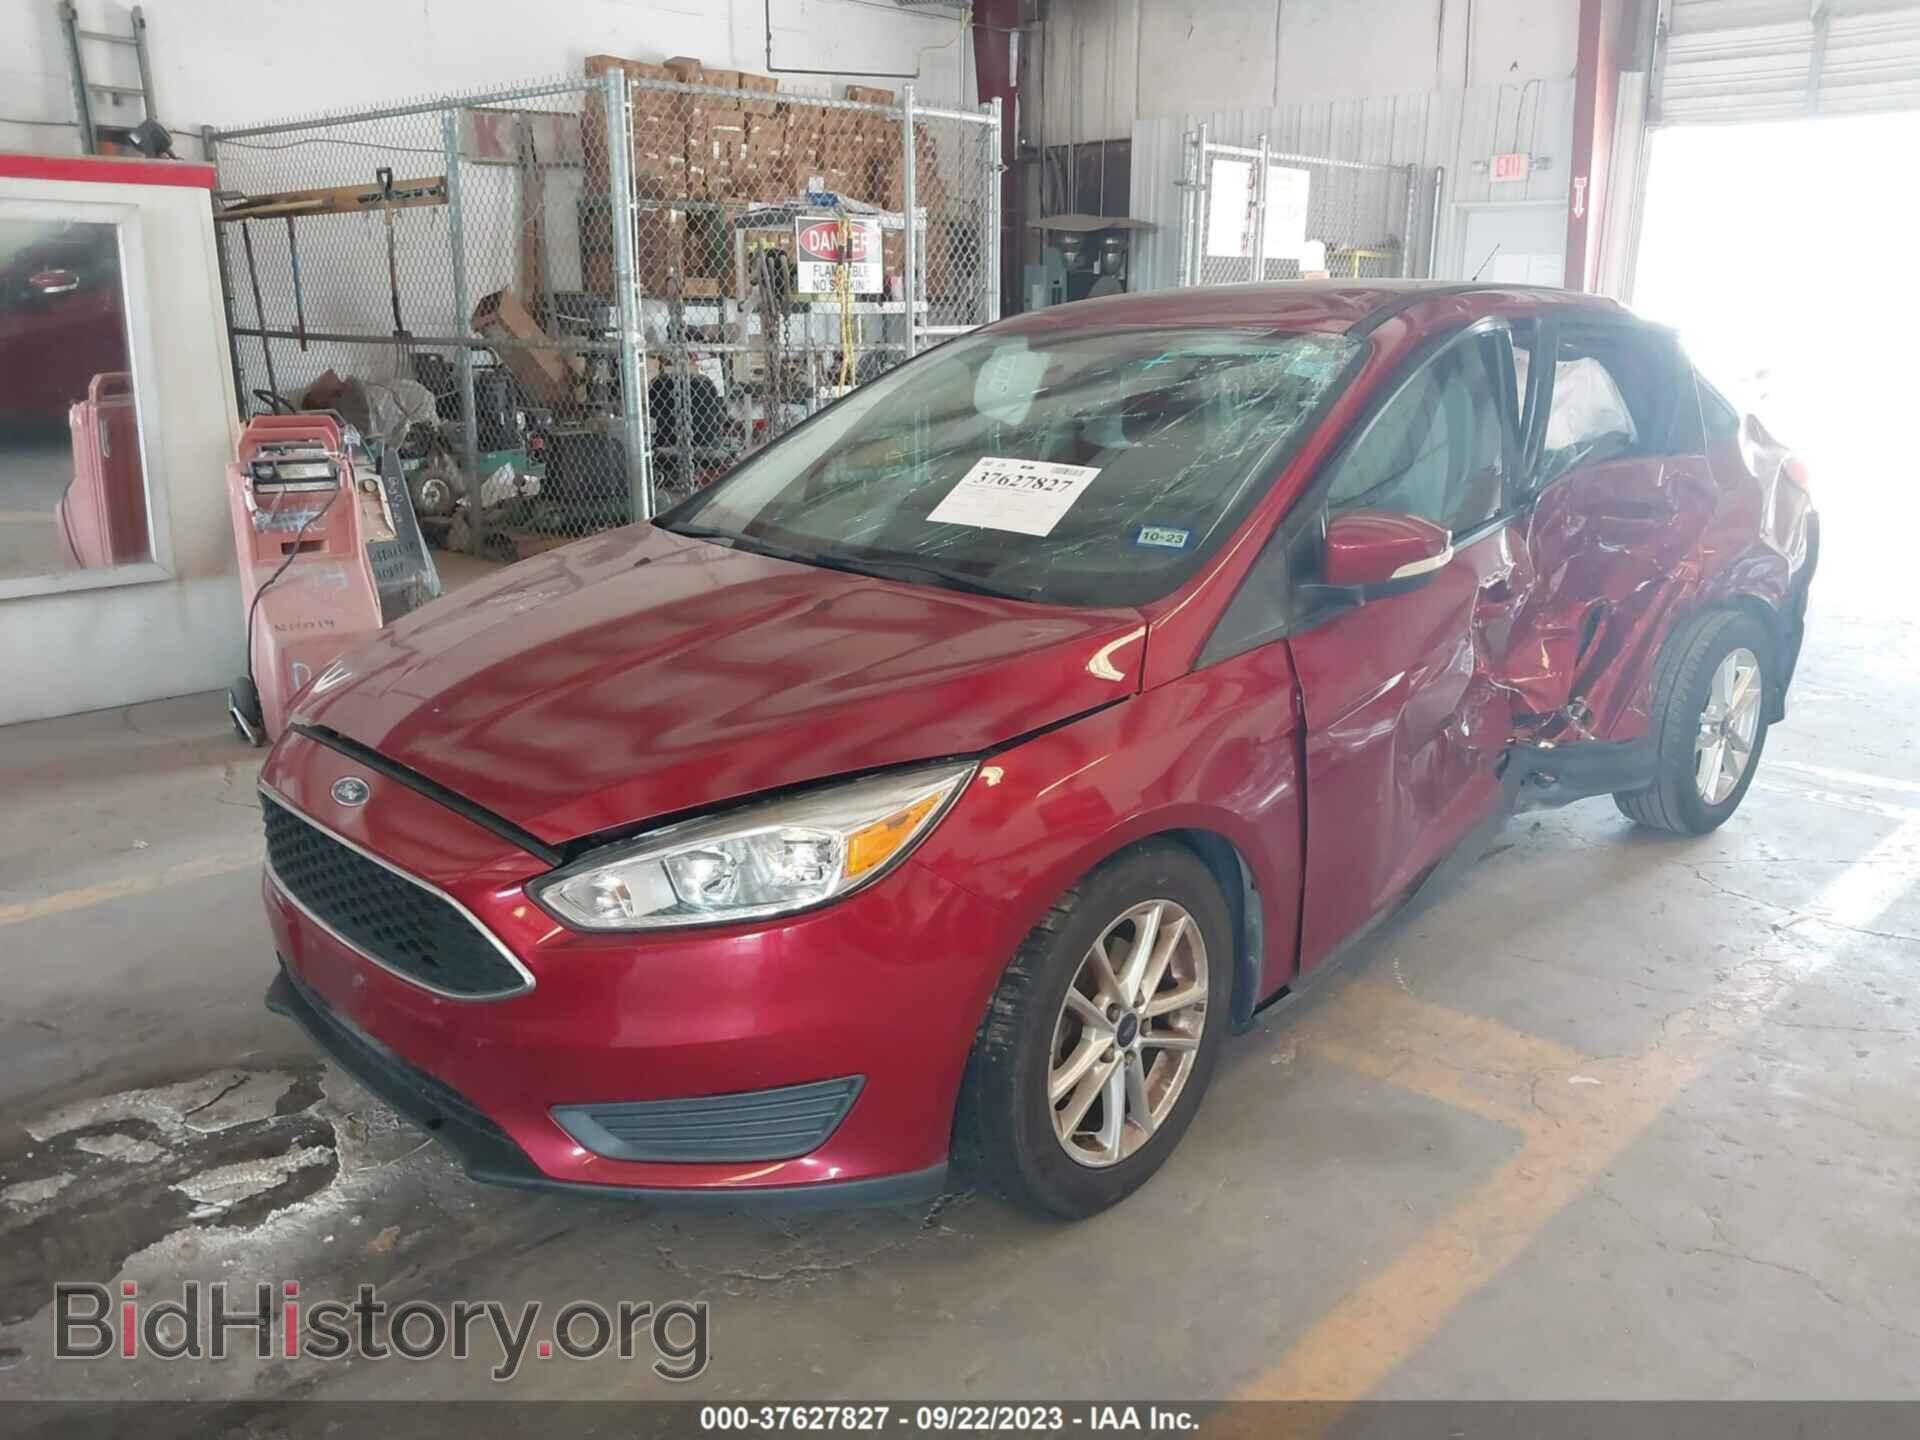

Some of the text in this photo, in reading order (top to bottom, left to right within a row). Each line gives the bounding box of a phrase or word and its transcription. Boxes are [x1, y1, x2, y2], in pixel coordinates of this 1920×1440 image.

[813, 280, 827, 291] NO
[974, 470, 1074, 494] 37627827
[1143, 531, 1184, 544] 10-23
